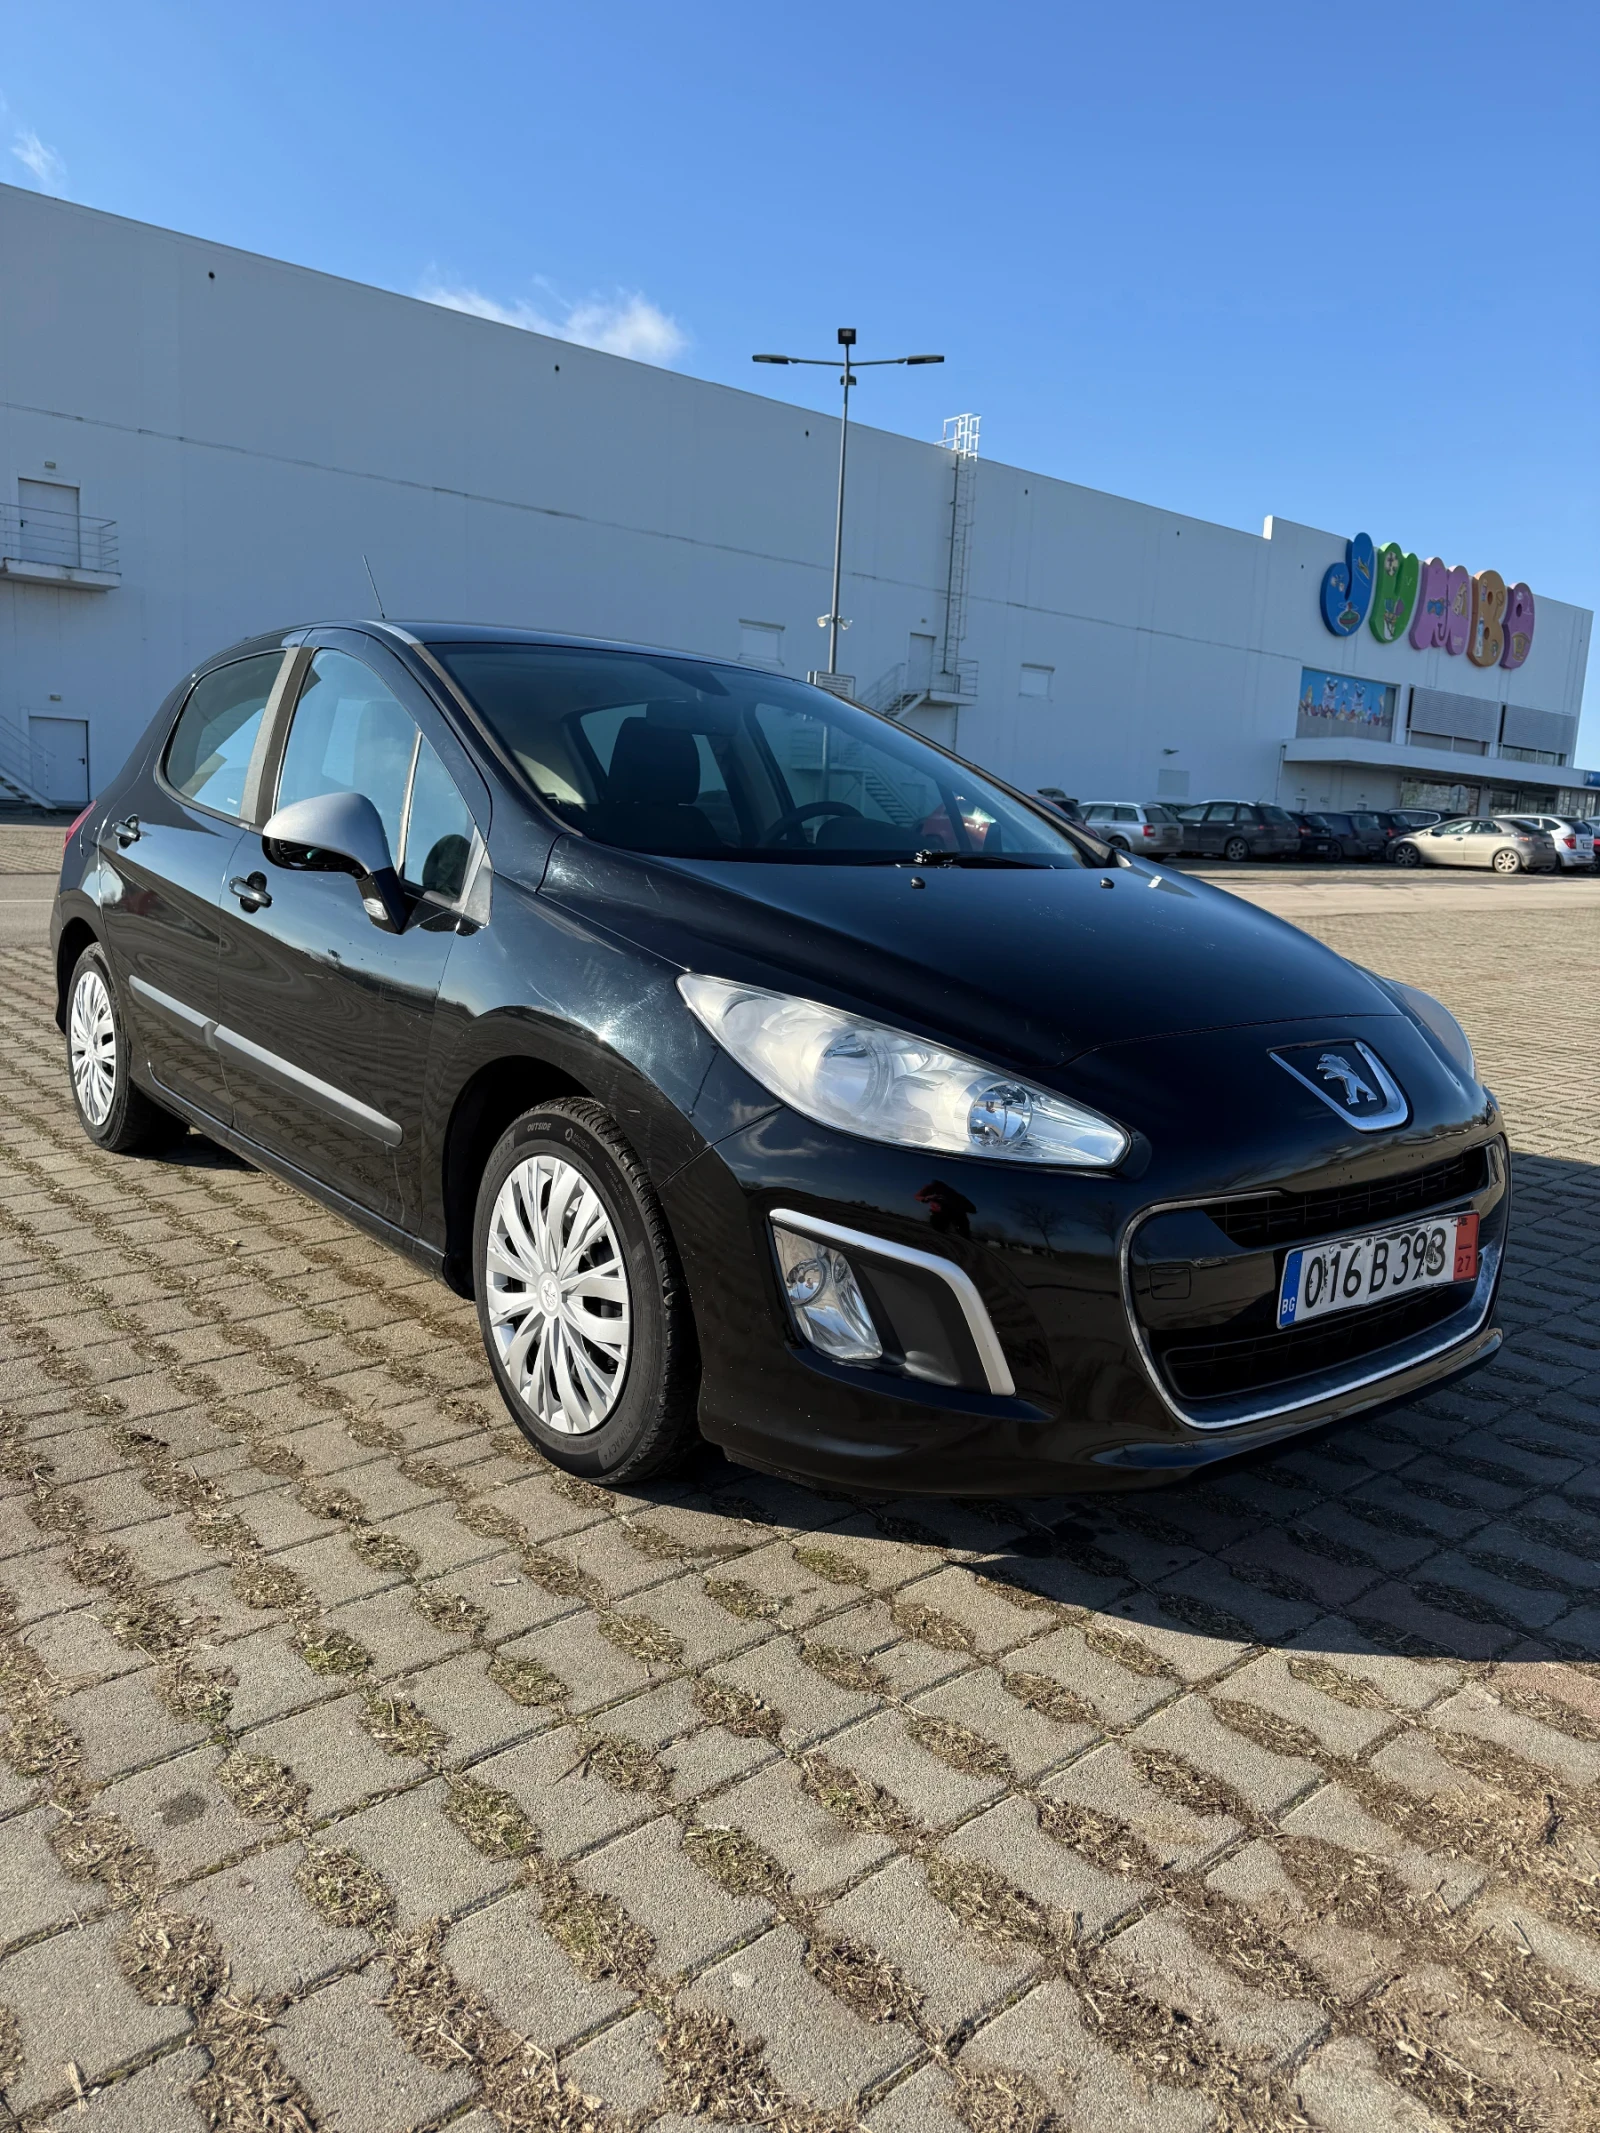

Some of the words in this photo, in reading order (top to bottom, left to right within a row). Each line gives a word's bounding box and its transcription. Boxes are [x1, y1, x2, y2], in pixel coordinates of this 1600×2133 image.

[1320, 532, 1535, 669] JUMBO
[527, 1122, 551, 1131] OUTSIDE
[1281, 1297, 1295, 1315] BG
[1456, 1255, 1471, 1273] 27
